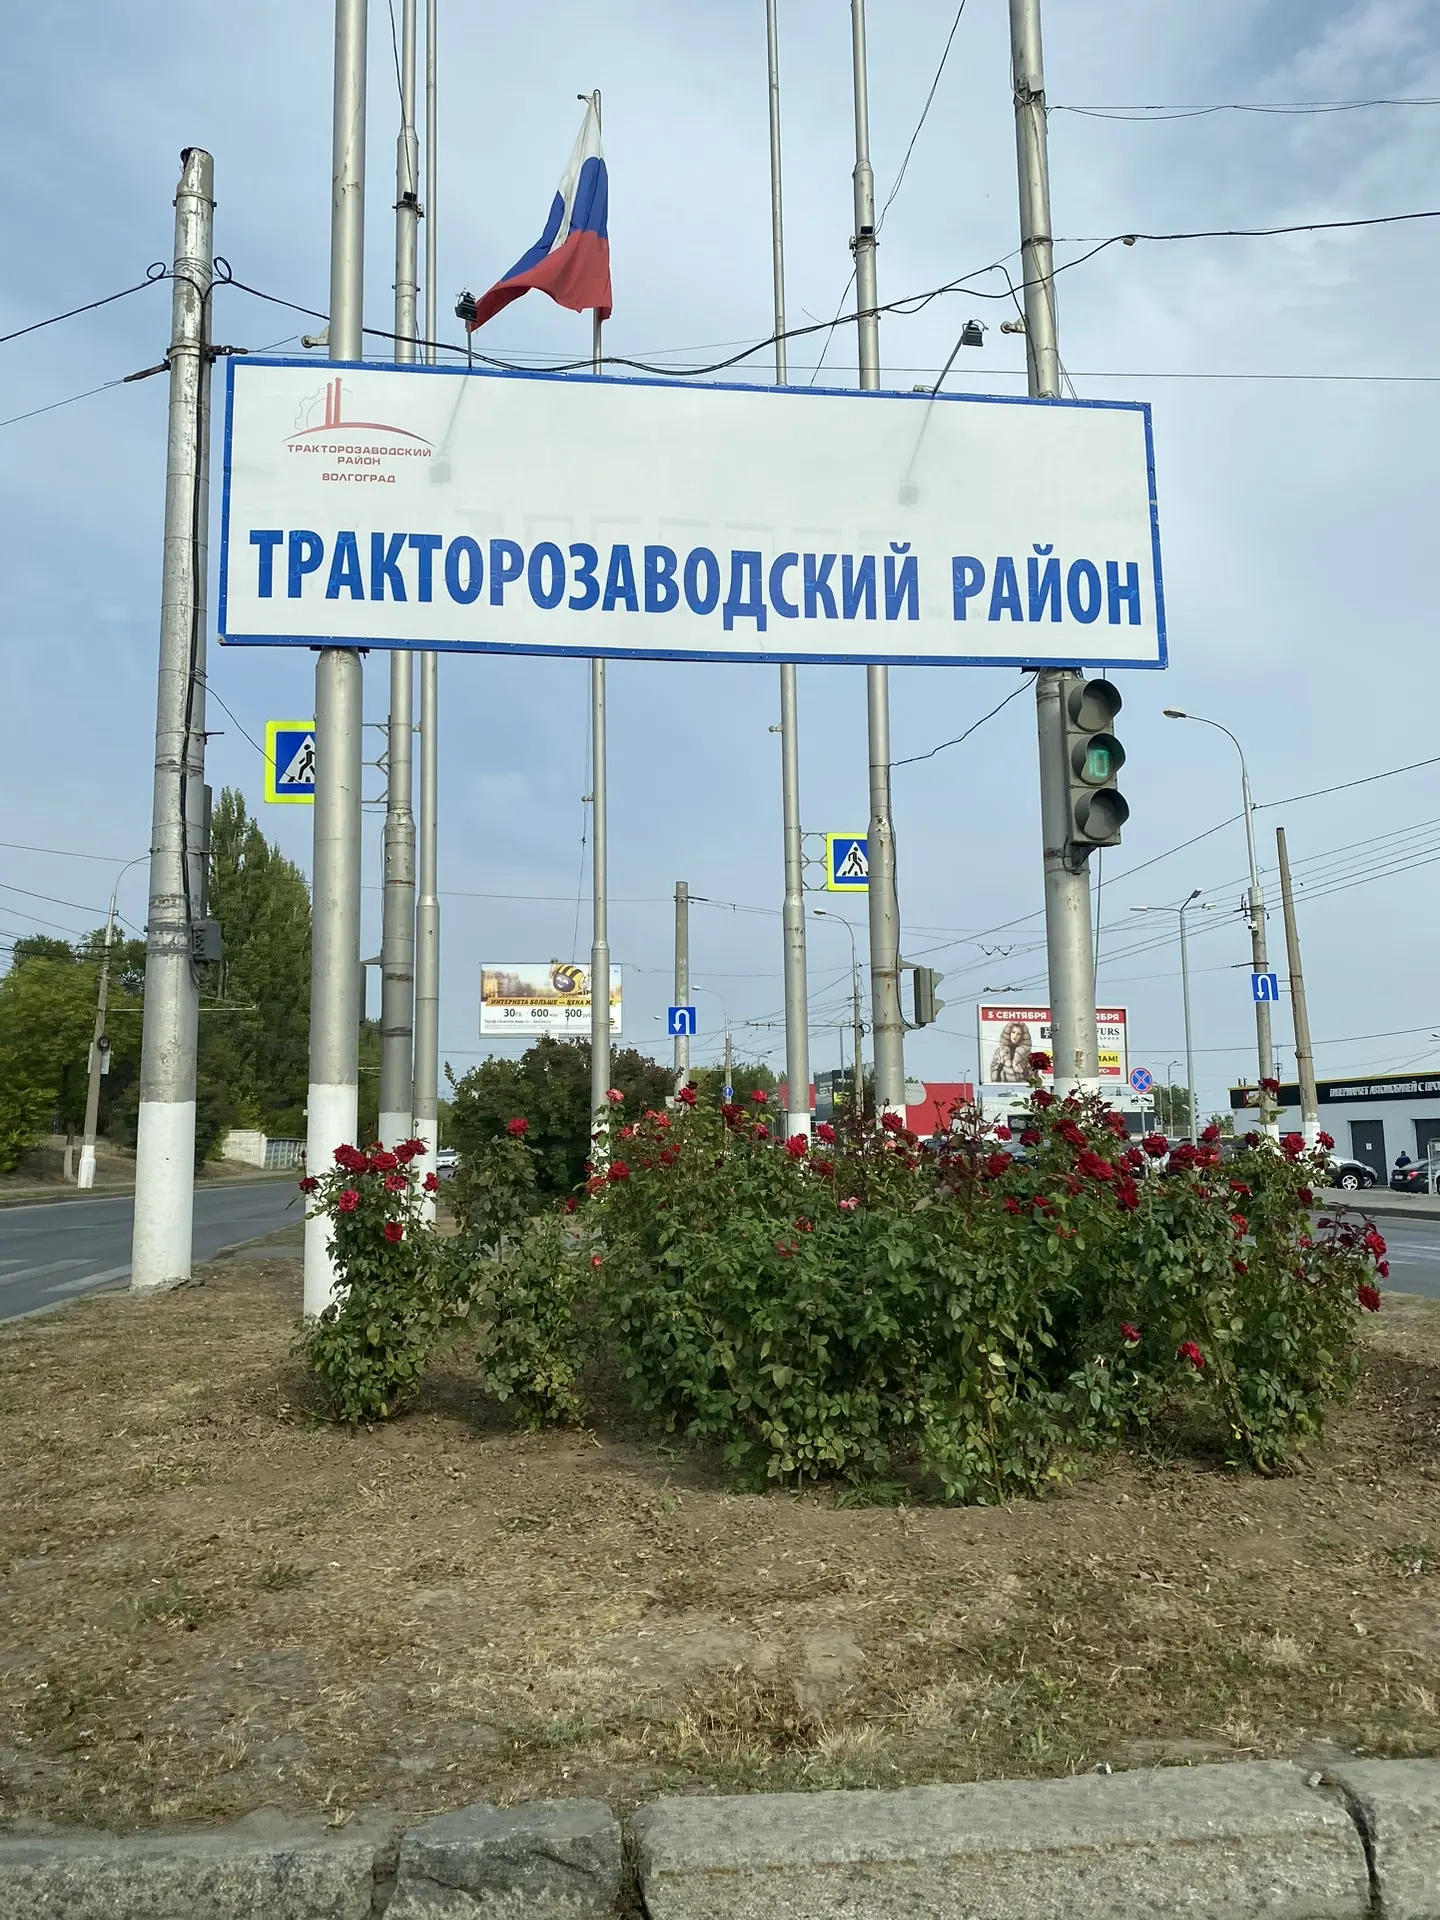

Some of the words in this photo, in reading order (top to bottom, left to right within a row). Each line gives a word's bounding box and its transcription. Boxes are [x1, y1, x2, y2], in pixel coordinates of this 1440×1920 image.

[287, 444, 432, 457] ТРАКТОРОЗАВОДСКИЙ
[337, 455, 381, 465] РАЙОН
[322, 473, 396, 483] ВОЛГОГРАД
[249, 529, 919, 632] ТРАКТОРОЗАВОДСКИЙ
[952, 543, 1142, 626] РАЙОН
[504, 1008, 515, 1017] 30
[531, 1008, 549, 1018] 600
[565, 1009, 582, 1018] 500
[988, 1011, 994, 1019] 5
[996, 1011, 1047, 1020] СЕНТЯБРЯ
